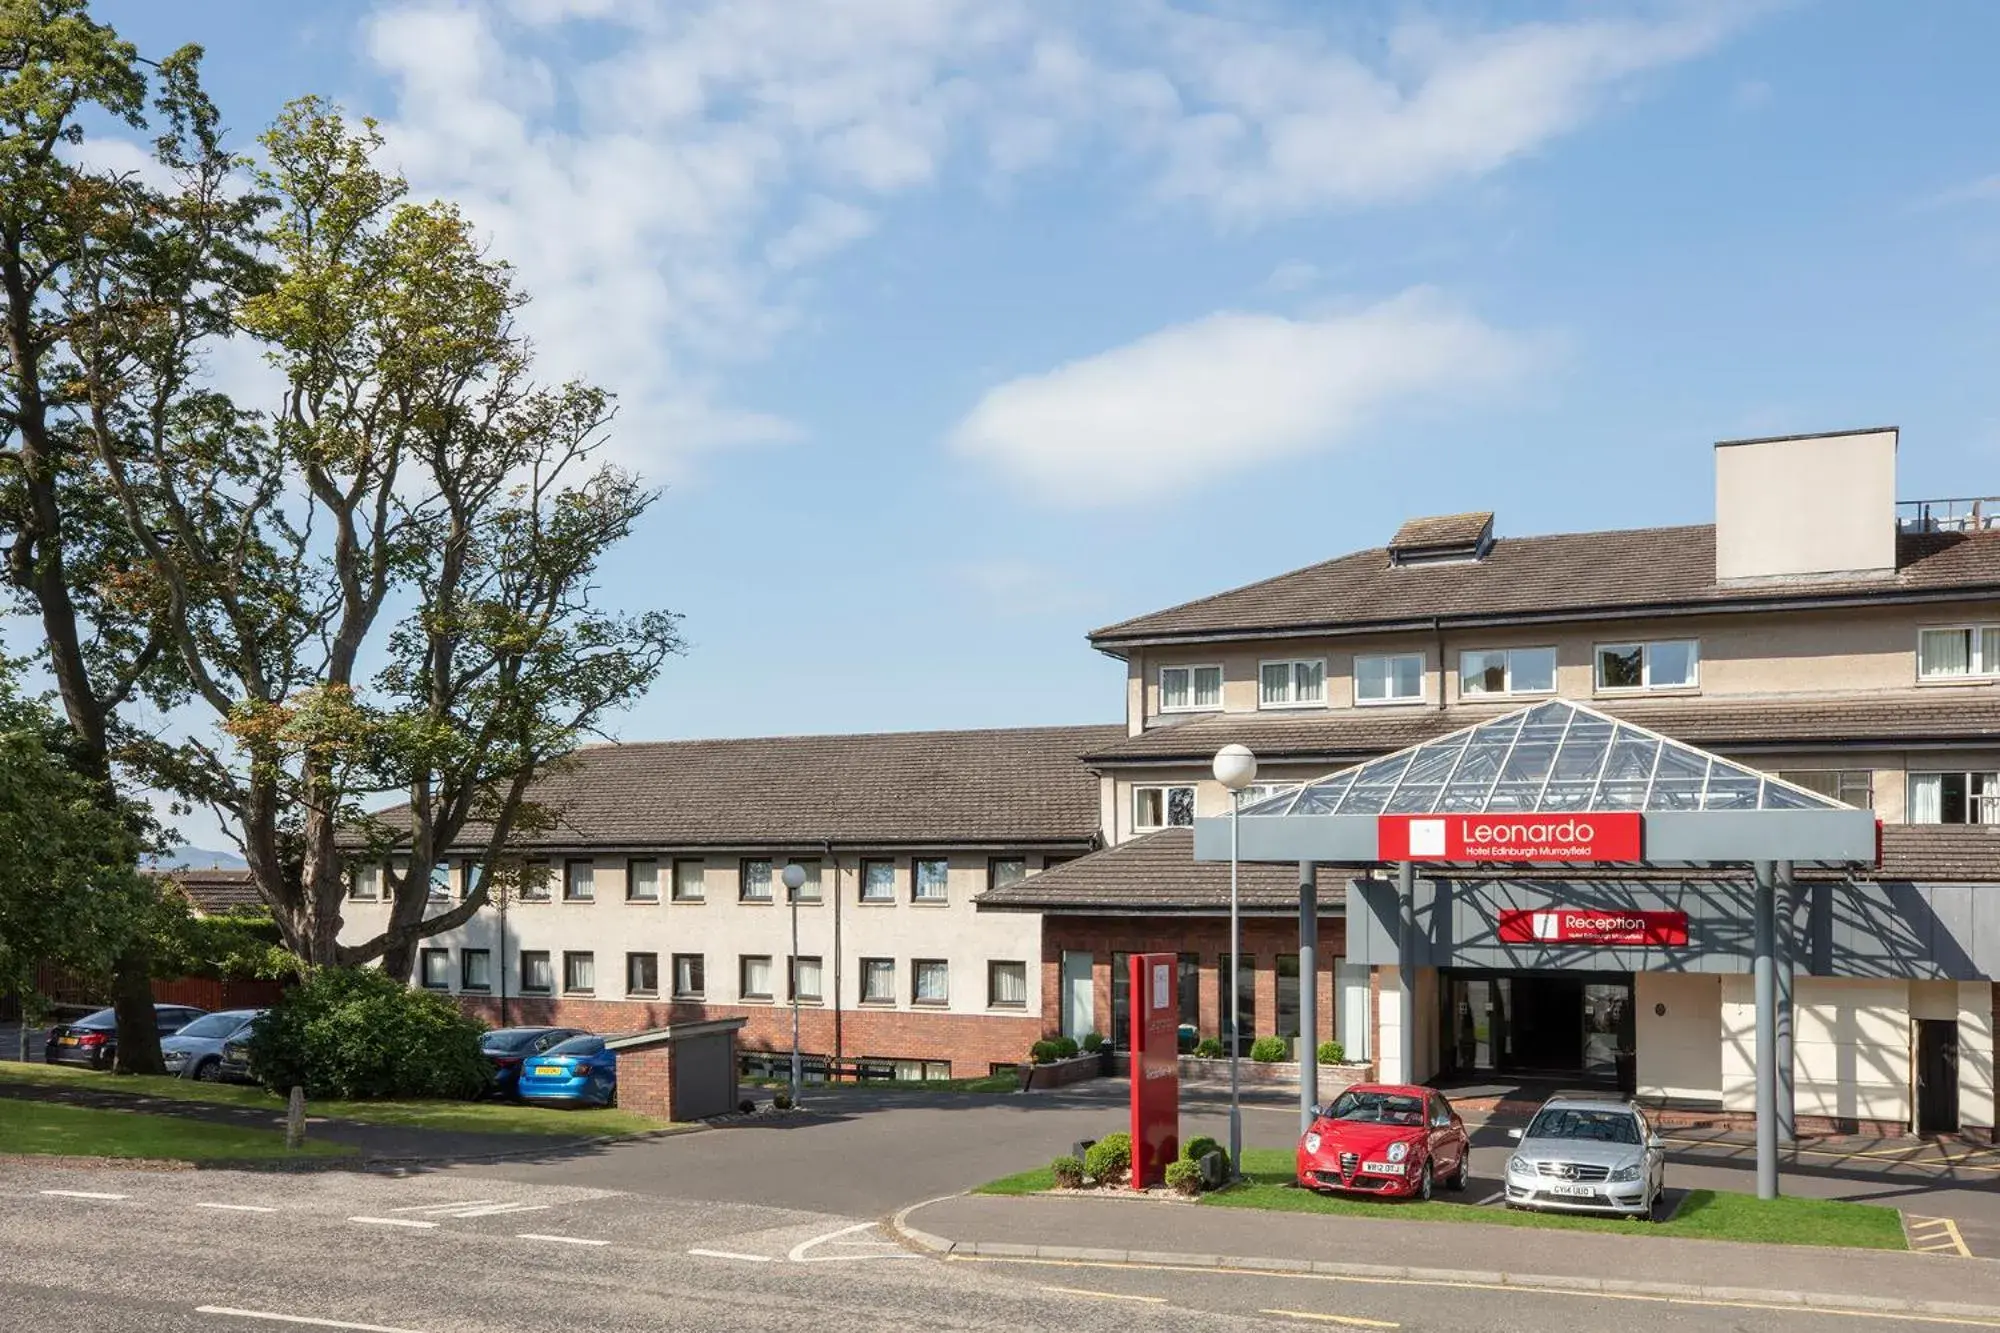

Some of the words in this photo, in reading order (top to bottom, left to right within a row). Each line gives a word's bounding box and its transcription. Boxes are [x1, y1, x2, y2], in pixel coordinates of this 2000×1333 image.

[1462, 819, 1595, 843] Leonardo
[1466, 846, 1490, 856] Hotel
[1491, 846, 1538, 858] Edinburgh
[1539, 846, 1592, 857] Murrayfield
[1565, 915, 1645, 931] Reception
